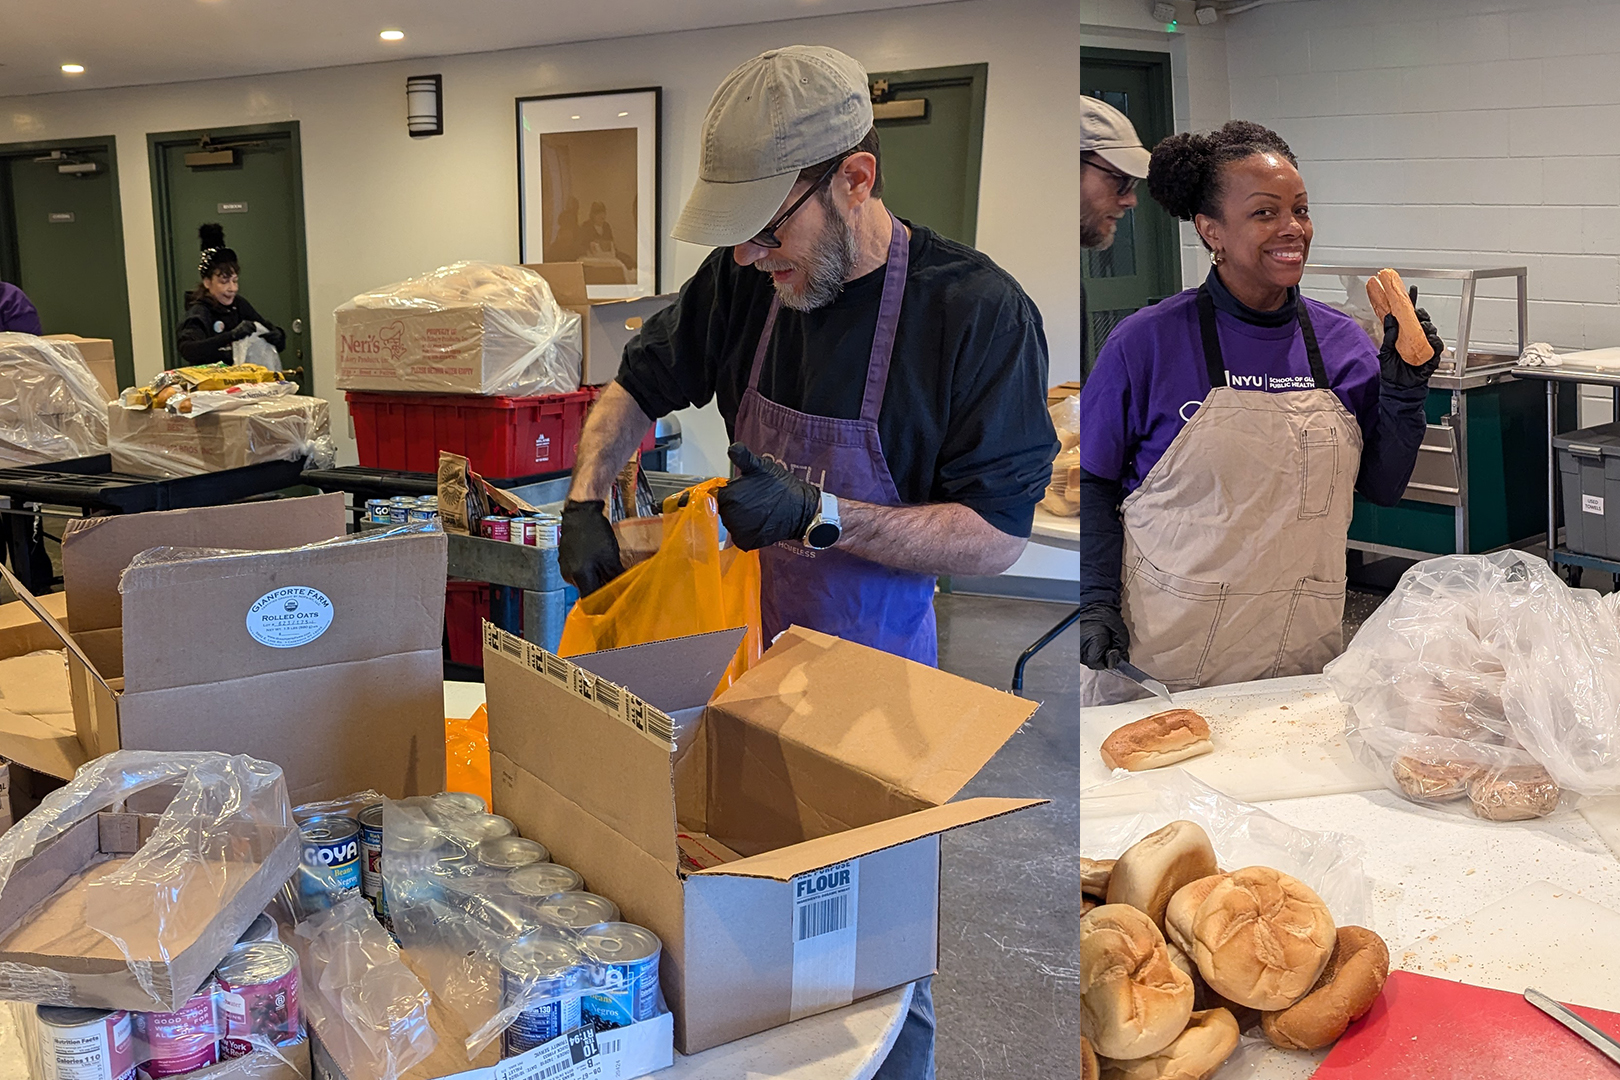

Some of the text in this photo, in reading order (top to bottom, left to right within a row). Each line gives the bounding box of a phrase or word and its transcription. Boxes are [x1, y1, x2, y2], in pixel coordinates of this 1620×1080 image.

[341, 334, 380, 354] Neri's
[1232, 375, 1263, 387] NYU
[1269, 376, 1294, 384] SCHOOL
[1585, 503, 1602, 511] TOWELS
[251, 588, 329, 613] GIANFORTE FARM
[261, 614, 295, 622] ROLLED
[303, 840, 358, 867] GOYA
[334, 866, 353, 877] Beans
[796, 869, 851, 898] FLOUR
[540, 1005, 551, 1013] 130
[590, 1003, 619, 1017] Negros
[154, 1006, 208, 1025] GOOD FOOD
[194, 1014, 209, 1025] FOR
[54, 1035, 99, 1045] Nutrition Facts
[569, 1028, 595, 1047] RT:94
[584, 1037, 595, 1045] TEN
[230, 1039, 247, 1051] York
[583, 1044, 598, 1058] 10
[56, 1053, 101, 1065] Calories 110
[586, 1058, 594, 1068] B
